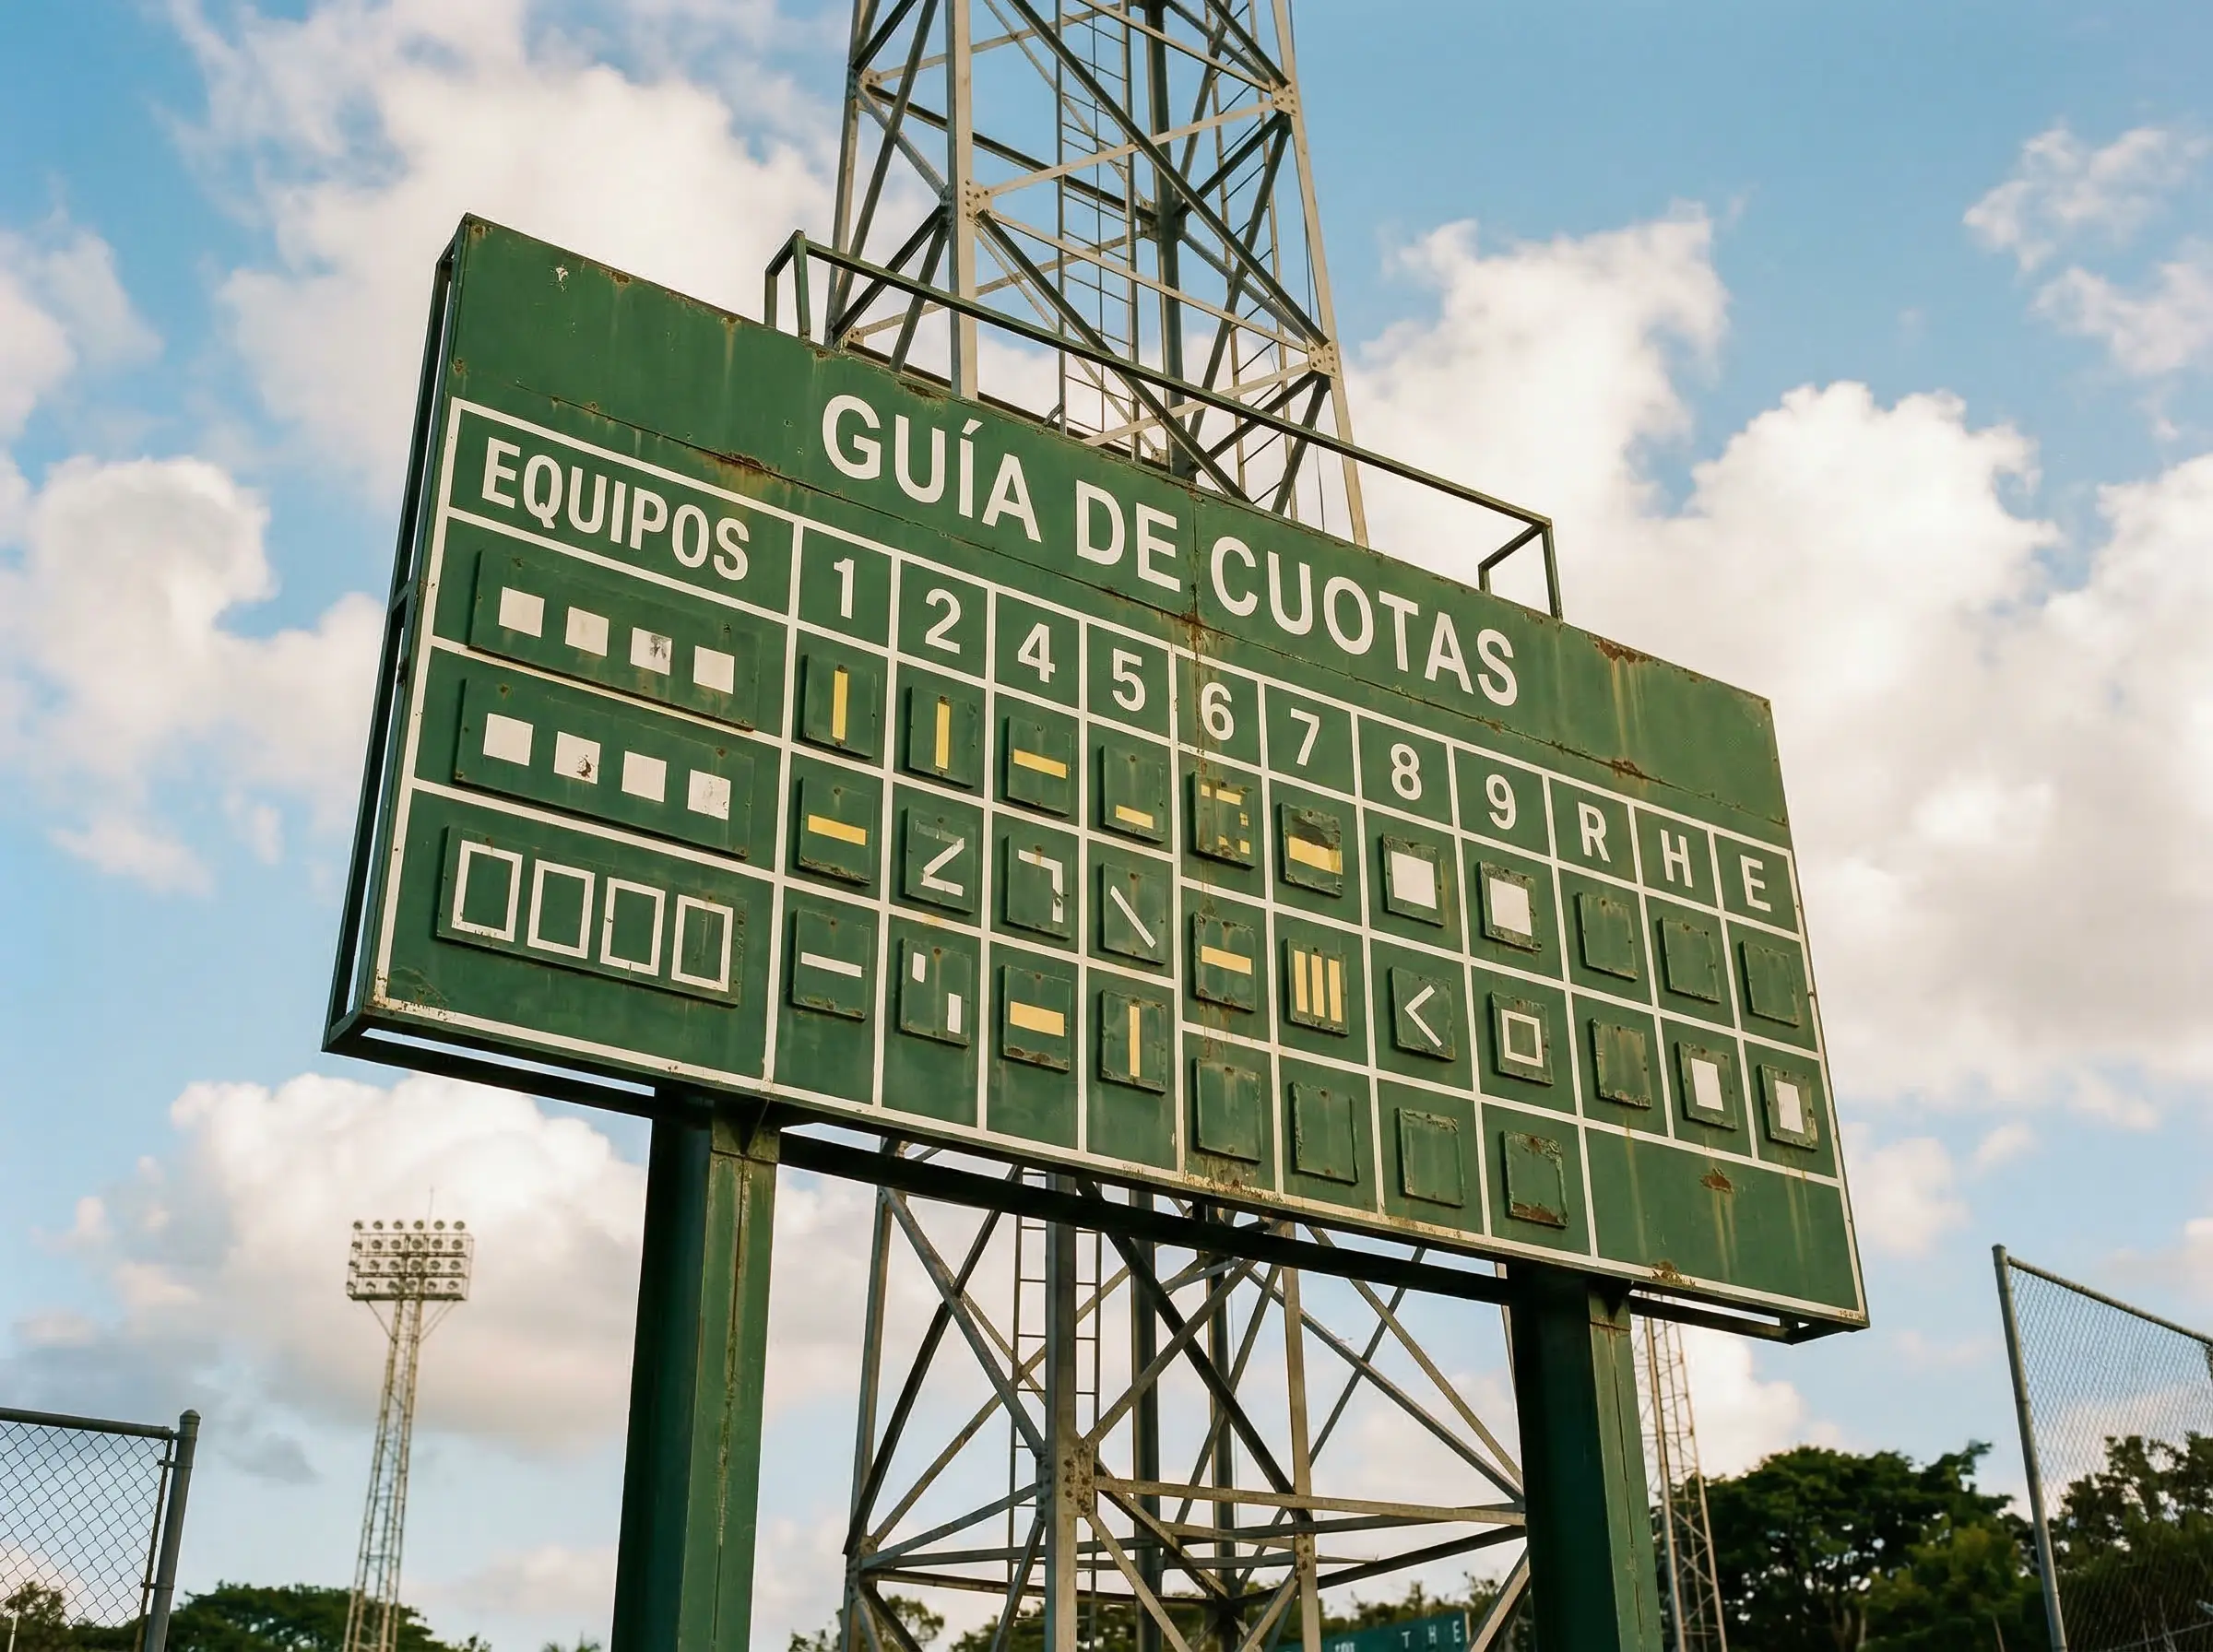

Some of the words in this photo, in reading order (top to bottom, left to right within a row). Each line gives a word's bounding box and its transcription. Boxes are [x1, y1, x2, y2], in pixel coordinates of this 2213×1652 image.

[481, 437, 750, 581] EQUIPOS
[833, 558, 855, 620] 1
[924, 588, 962, 655] 2
[1017, 622, 1056, 684] 4
[1112, 647, 1146, 712] 5
[1201, 681, 1235, 741] 6
[1290, 708, 1320, 767] 7
[1391, 743, 1423, 800] 8
[1486, 774, 1517, 831] 9
[1578, 801, 1612, 863] R
[1661, 828, 1694, 889] H
[1740, 855, 1772, 913] E
[822, 394, 1043, 544] GUÍA
[1076, 478, 1181, 593] DE
[1210, 536, 1519, 707] CUOTAS
